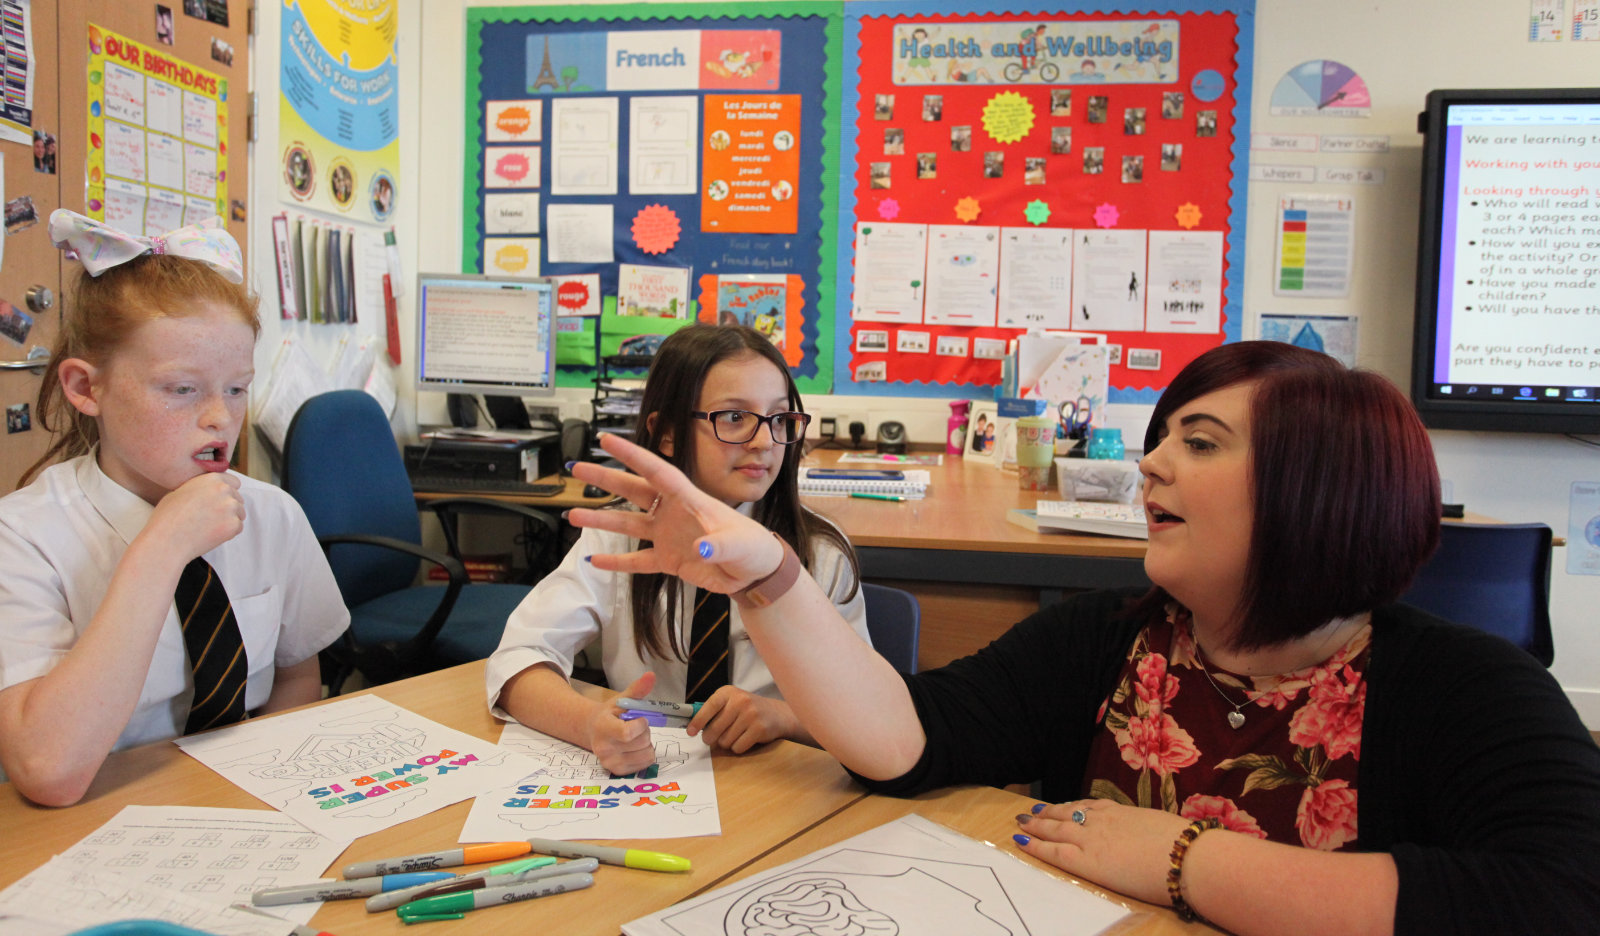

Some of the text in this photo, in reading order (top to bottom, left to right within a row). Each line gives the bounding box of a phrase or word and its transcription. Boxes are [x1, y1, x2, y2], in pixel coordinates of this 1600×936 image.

[1540, 10, 1555, 22] 14
[1584, 9, 1599, 21] 15
[900, 36, 1173, 63] Health and Wellbeing
[292, 19, 332, 78] SKILLS
[334, 70, 358, 93] FOR
[360, 69, 391, 93] WORK
[616, 47, 685, 69] French
[105, 36, 140, 66] OUR
[143, 51, 217, 95] BIRTHDAYS
[724, 101, 782, 110] Les Jours de
[727, 111, 778, 120] la Semaine
[1466, 135, 1489, 144] We
[1494, 136, 1517, 144] are
[1523, 134, 1586, 146] learning
[738, 167, 762, 176] jeudi
[1466, 160, 1528, 172] Working
[1534, 160, 1568, 168] with
[1464, 186, 1523, 198] Looking
[1529, 186, 1590, 198] through
[728, 204, 771, 212] dimanche
[1484, 200, 1517, 208] Who
[1522, 199, 1550, 208] will
[1555, 200, 1588, 208] read
[500, 208, 523, 217] blanc
[1483, 213, 1492, 222] 3
[1497, 214, 1512, 222] or
[1518, 213, 1526, 222] 4
[1532, 214, 1575, 224] pages
[1482, 226, 1524, 235] each?
[1529, 226, 1576, 235] Which
[1482, 239, 1516, 248] How
[1521, 238, 1547, 248] will
[1554, 240, 1580, 251] you
[722, 253, 750, 266] French
[1481, 252, 1598, 264] the activity? Or
[1480, 265, 1496, 277] of
[1500, 266, 1512, 274] in
[1532, 266, 1578, 276] whole
[628, 282, 679, 294] THOUSAND
[1479, 279, 1596, 290] Have you made
[559, 292, 585, 302] rouge
[1478, 292, 1546, 301] children?
[1478, 304, 1506, 314] Will
[1512, 306, 1538, 316] you
[1544, 305, 1581, 315] have
[1456, 343, 1479, 352] Are
[1485, 345, 1511, 355] you
[1517, 344, 1588, 356] confident
[1454, 357, 1486, 367] part
[1490, 356, 1522, 368] they
[1527, 358, 1563, 367] have
[1569, 358, 1584, 367] to
[307, 749, 459, 799] POWER IS
[320, 753, 480, 810] MY SUPER
[516, 781, 680, 796] POWER IS
[503, 794, 688, 809] MY SUPER
